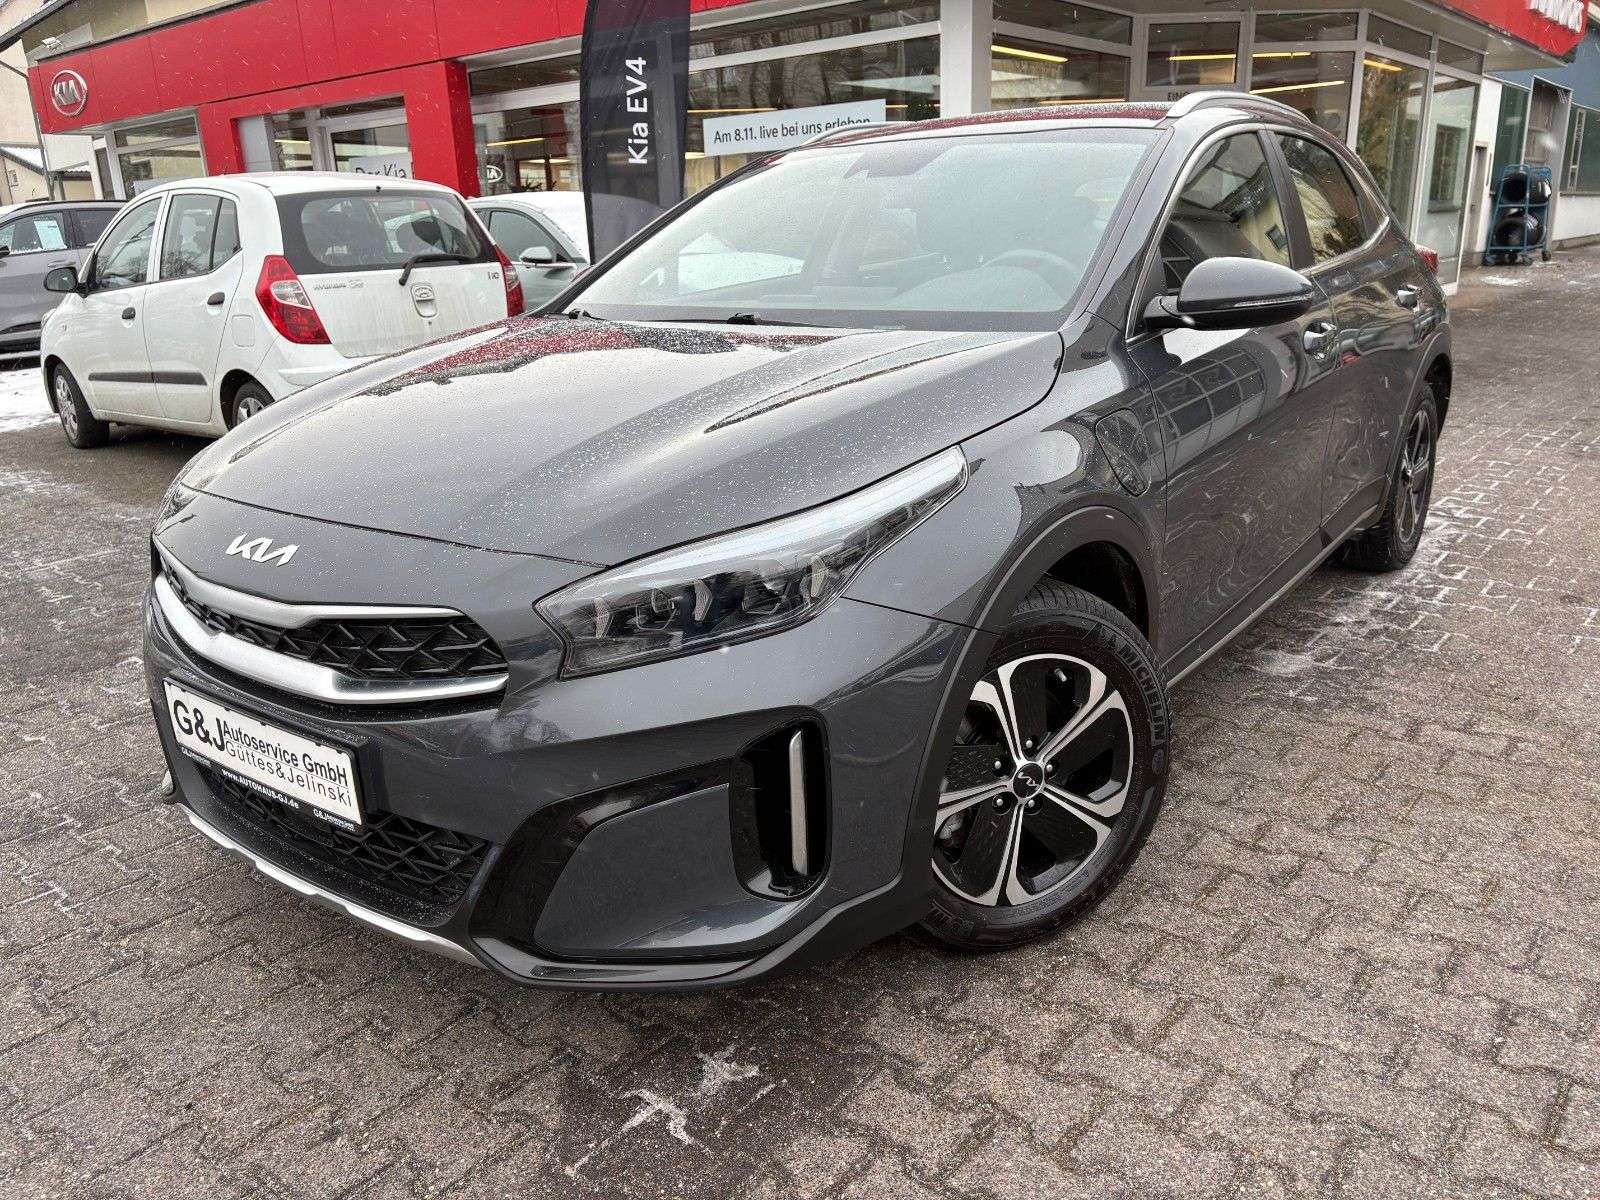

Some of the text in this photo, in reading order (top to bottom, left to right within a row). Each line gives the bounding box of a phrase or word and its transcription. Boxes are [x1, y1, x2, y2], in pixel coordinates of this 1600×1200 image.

[53, 79, 81, 105] KIA
[625, 57, 648, 164] Kia EV4
[713, 130, 732, 144] Am
[734, 127, 757, 142] 8.11.
[759, 125, 779, 139] live
[781, 122, 799, 137] bei
[801, 121, 822, 135] uns
[1115, 642, 1168, 747] MICHELIN
[173, 699, 226, 752] G&J
[223, 720, 348, 787] Autoservice GmbH
[221, 768, 299, 809] www.AUTOHAUS-GJ.de
[225, 740, 352, 807] Güttes&Jelinski
